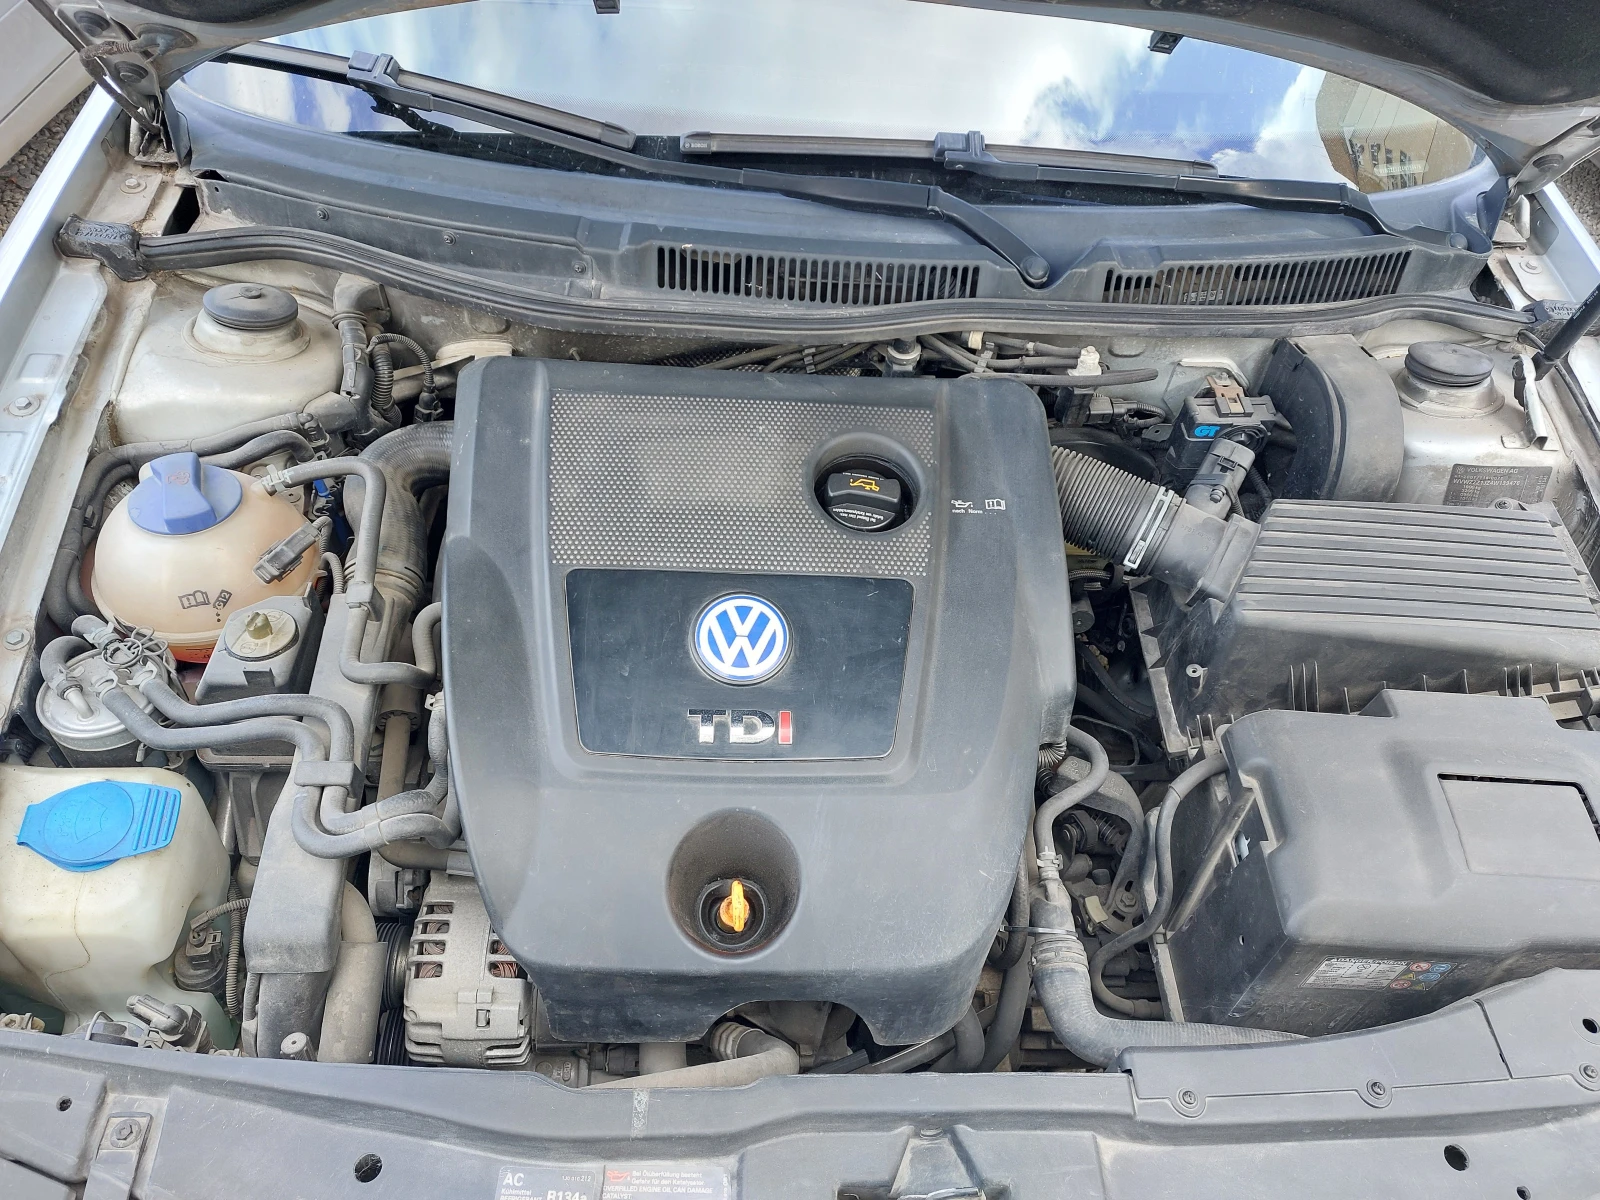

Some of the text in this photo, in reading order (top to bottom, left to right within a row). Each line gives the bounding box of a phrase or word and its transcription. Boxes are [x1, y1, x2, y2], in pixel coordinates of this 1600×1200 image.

[1194, 425, 1221, 437] GT
[687, 709, 793, 745] TDI
[503, 1173, 524, 1186] AC
[501, 1188, 532, 1196] Kühlmittel
[602, 1185, 637, 1194] OVERFILLED
[638, 1185, 662, 1194] ENGINE
[662, 1186, 672, 1194] OIL
